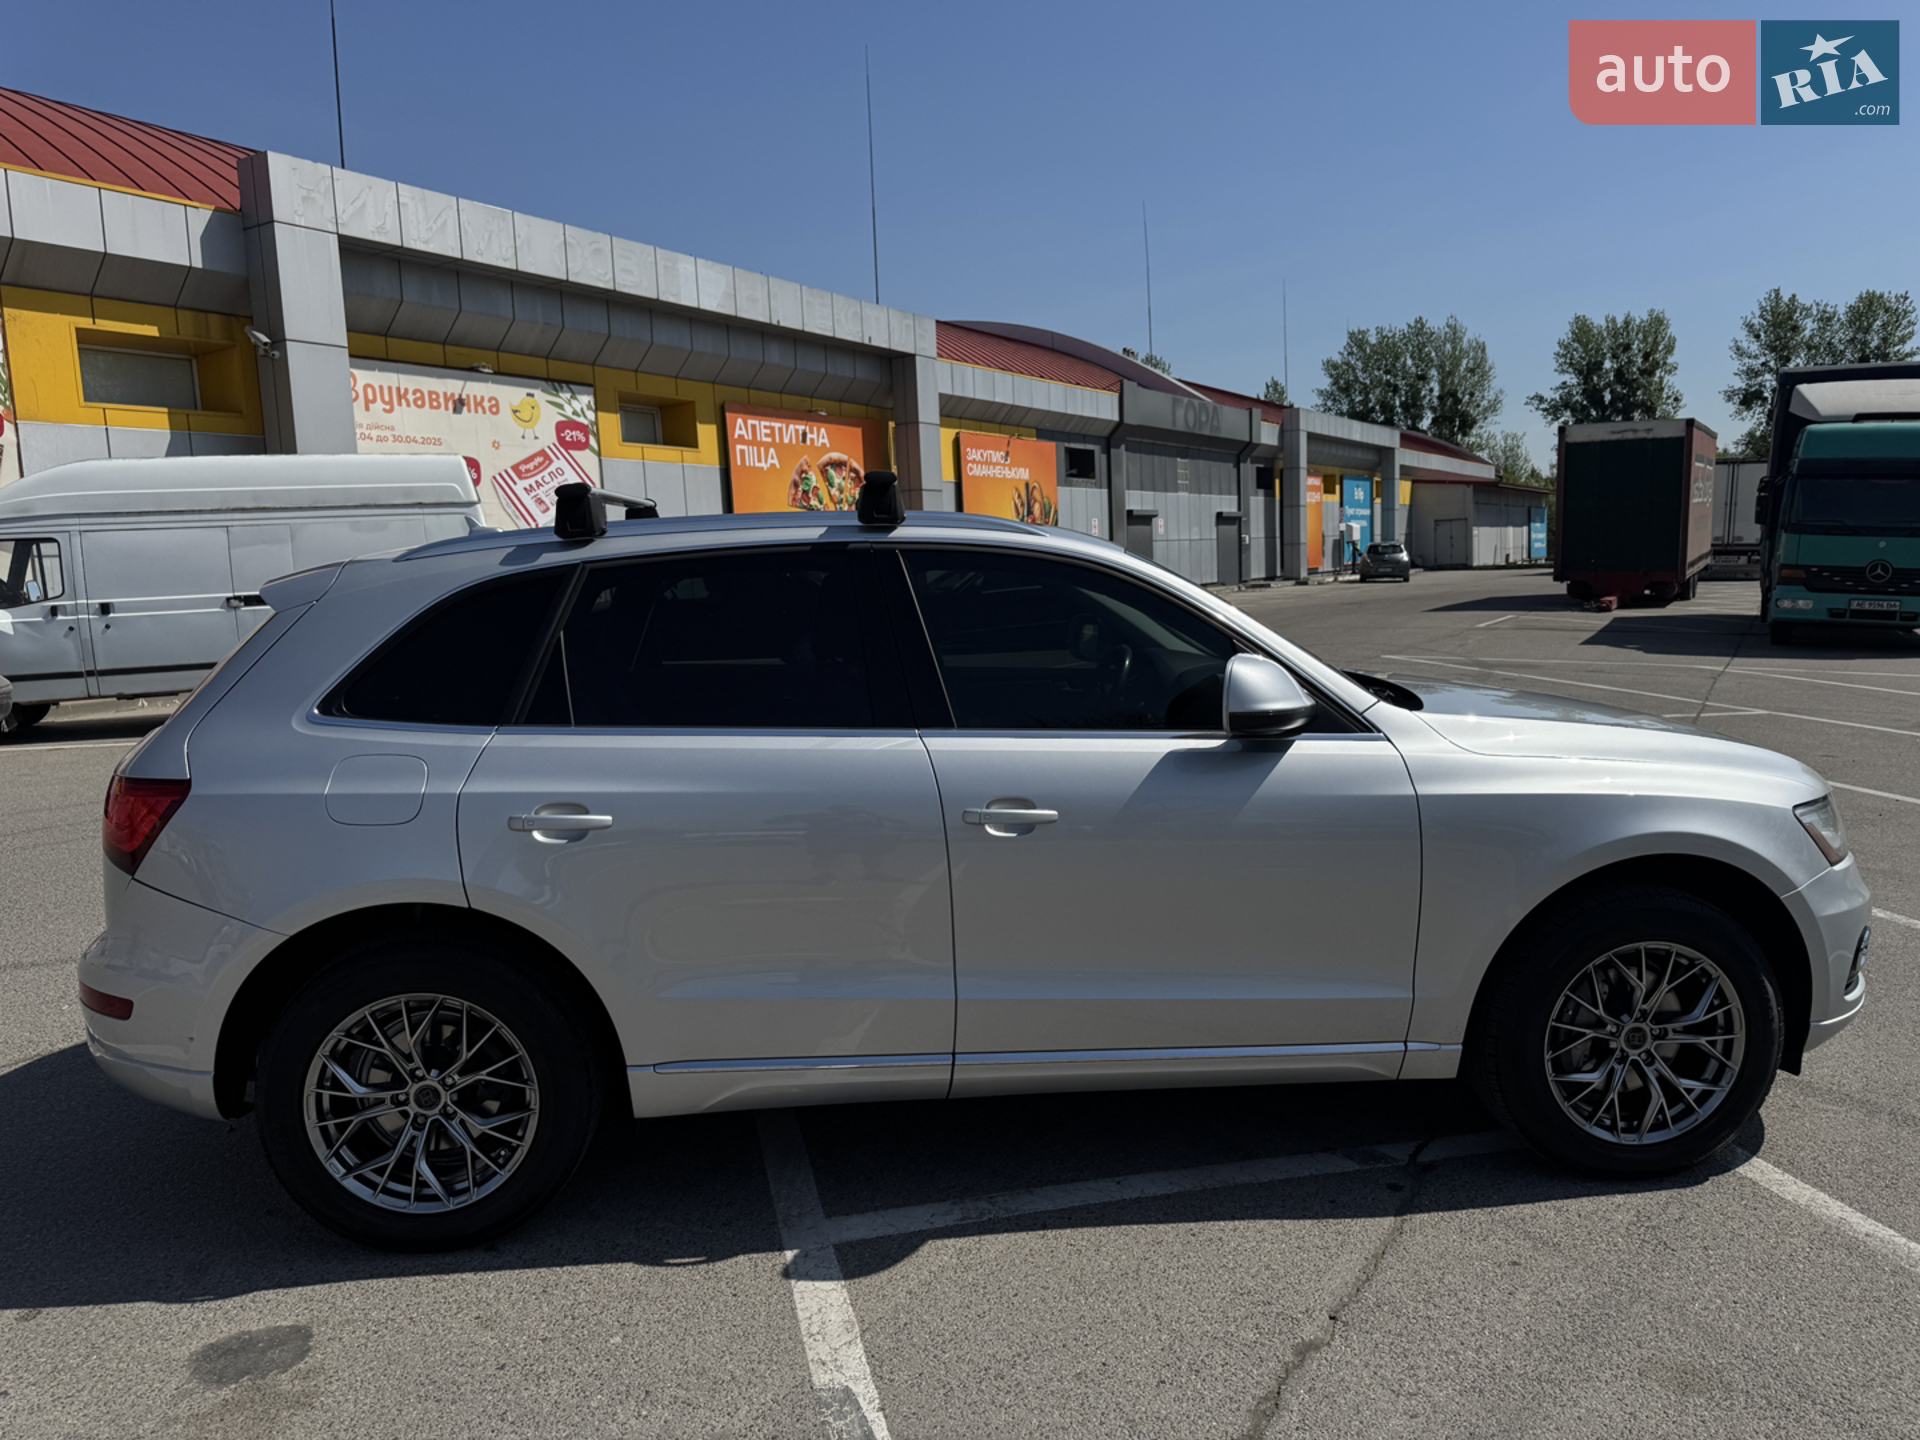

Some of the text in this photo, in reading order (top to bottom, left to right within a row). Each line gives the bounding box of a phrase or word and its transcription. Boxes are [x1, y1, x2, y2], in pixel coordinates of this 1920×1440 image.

[375, 435, 389, 443] до
[391, 434, 443, 447] 30.04.2025
[560, 429, 586, 442] -21%
[734, 418, 830, 448] АПЕТИТНА
[735, 444, 780, 471] ПІЦА
[523, 466, 565, 496] МАСЛО
